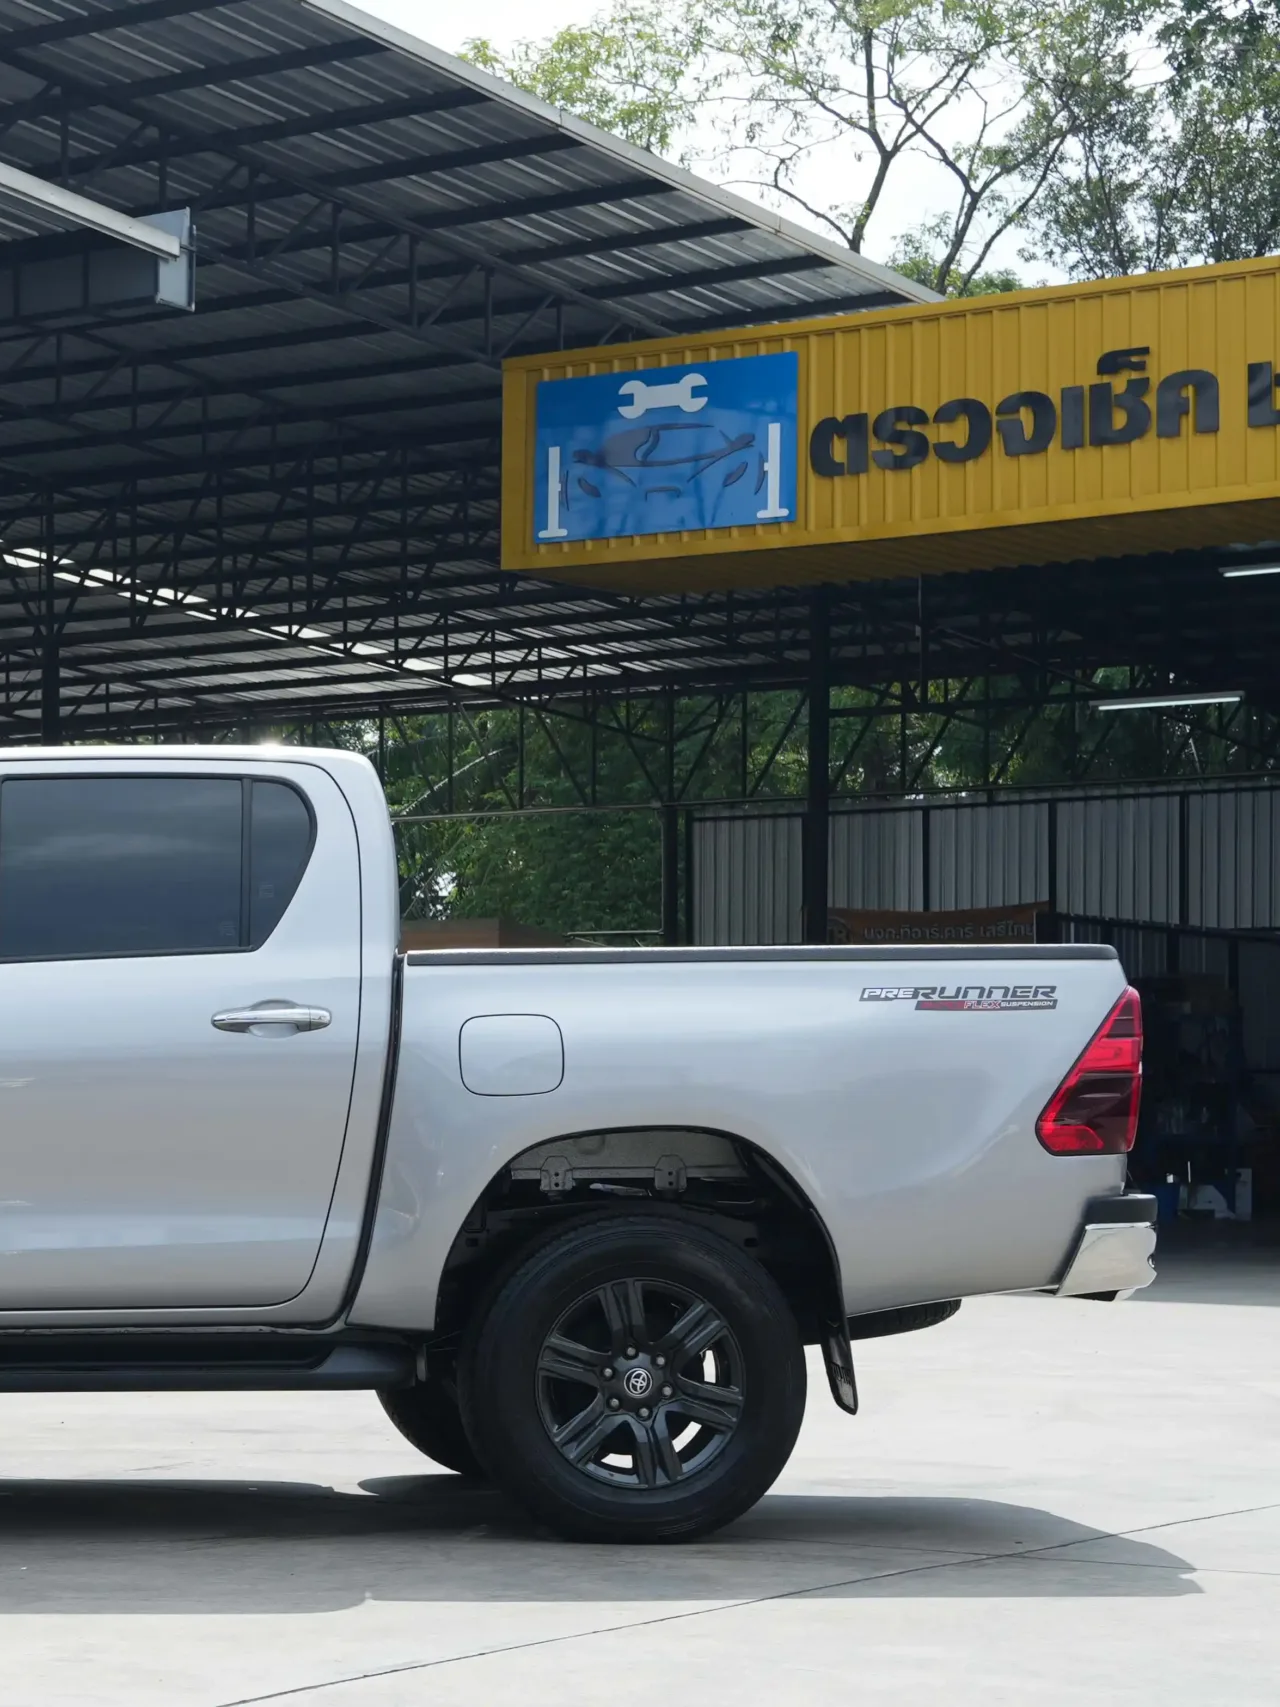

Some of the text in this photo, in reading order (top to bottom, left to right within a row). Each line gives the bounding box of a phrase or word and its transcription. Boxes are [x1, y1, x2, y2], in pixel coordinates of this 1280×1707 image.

[809, 346, 1220, 477] ตรวจเช็ค
[963, 1000, 1001, 1010] FLEX
[1001, 1000, 1054, 1008] SUSPENSION
